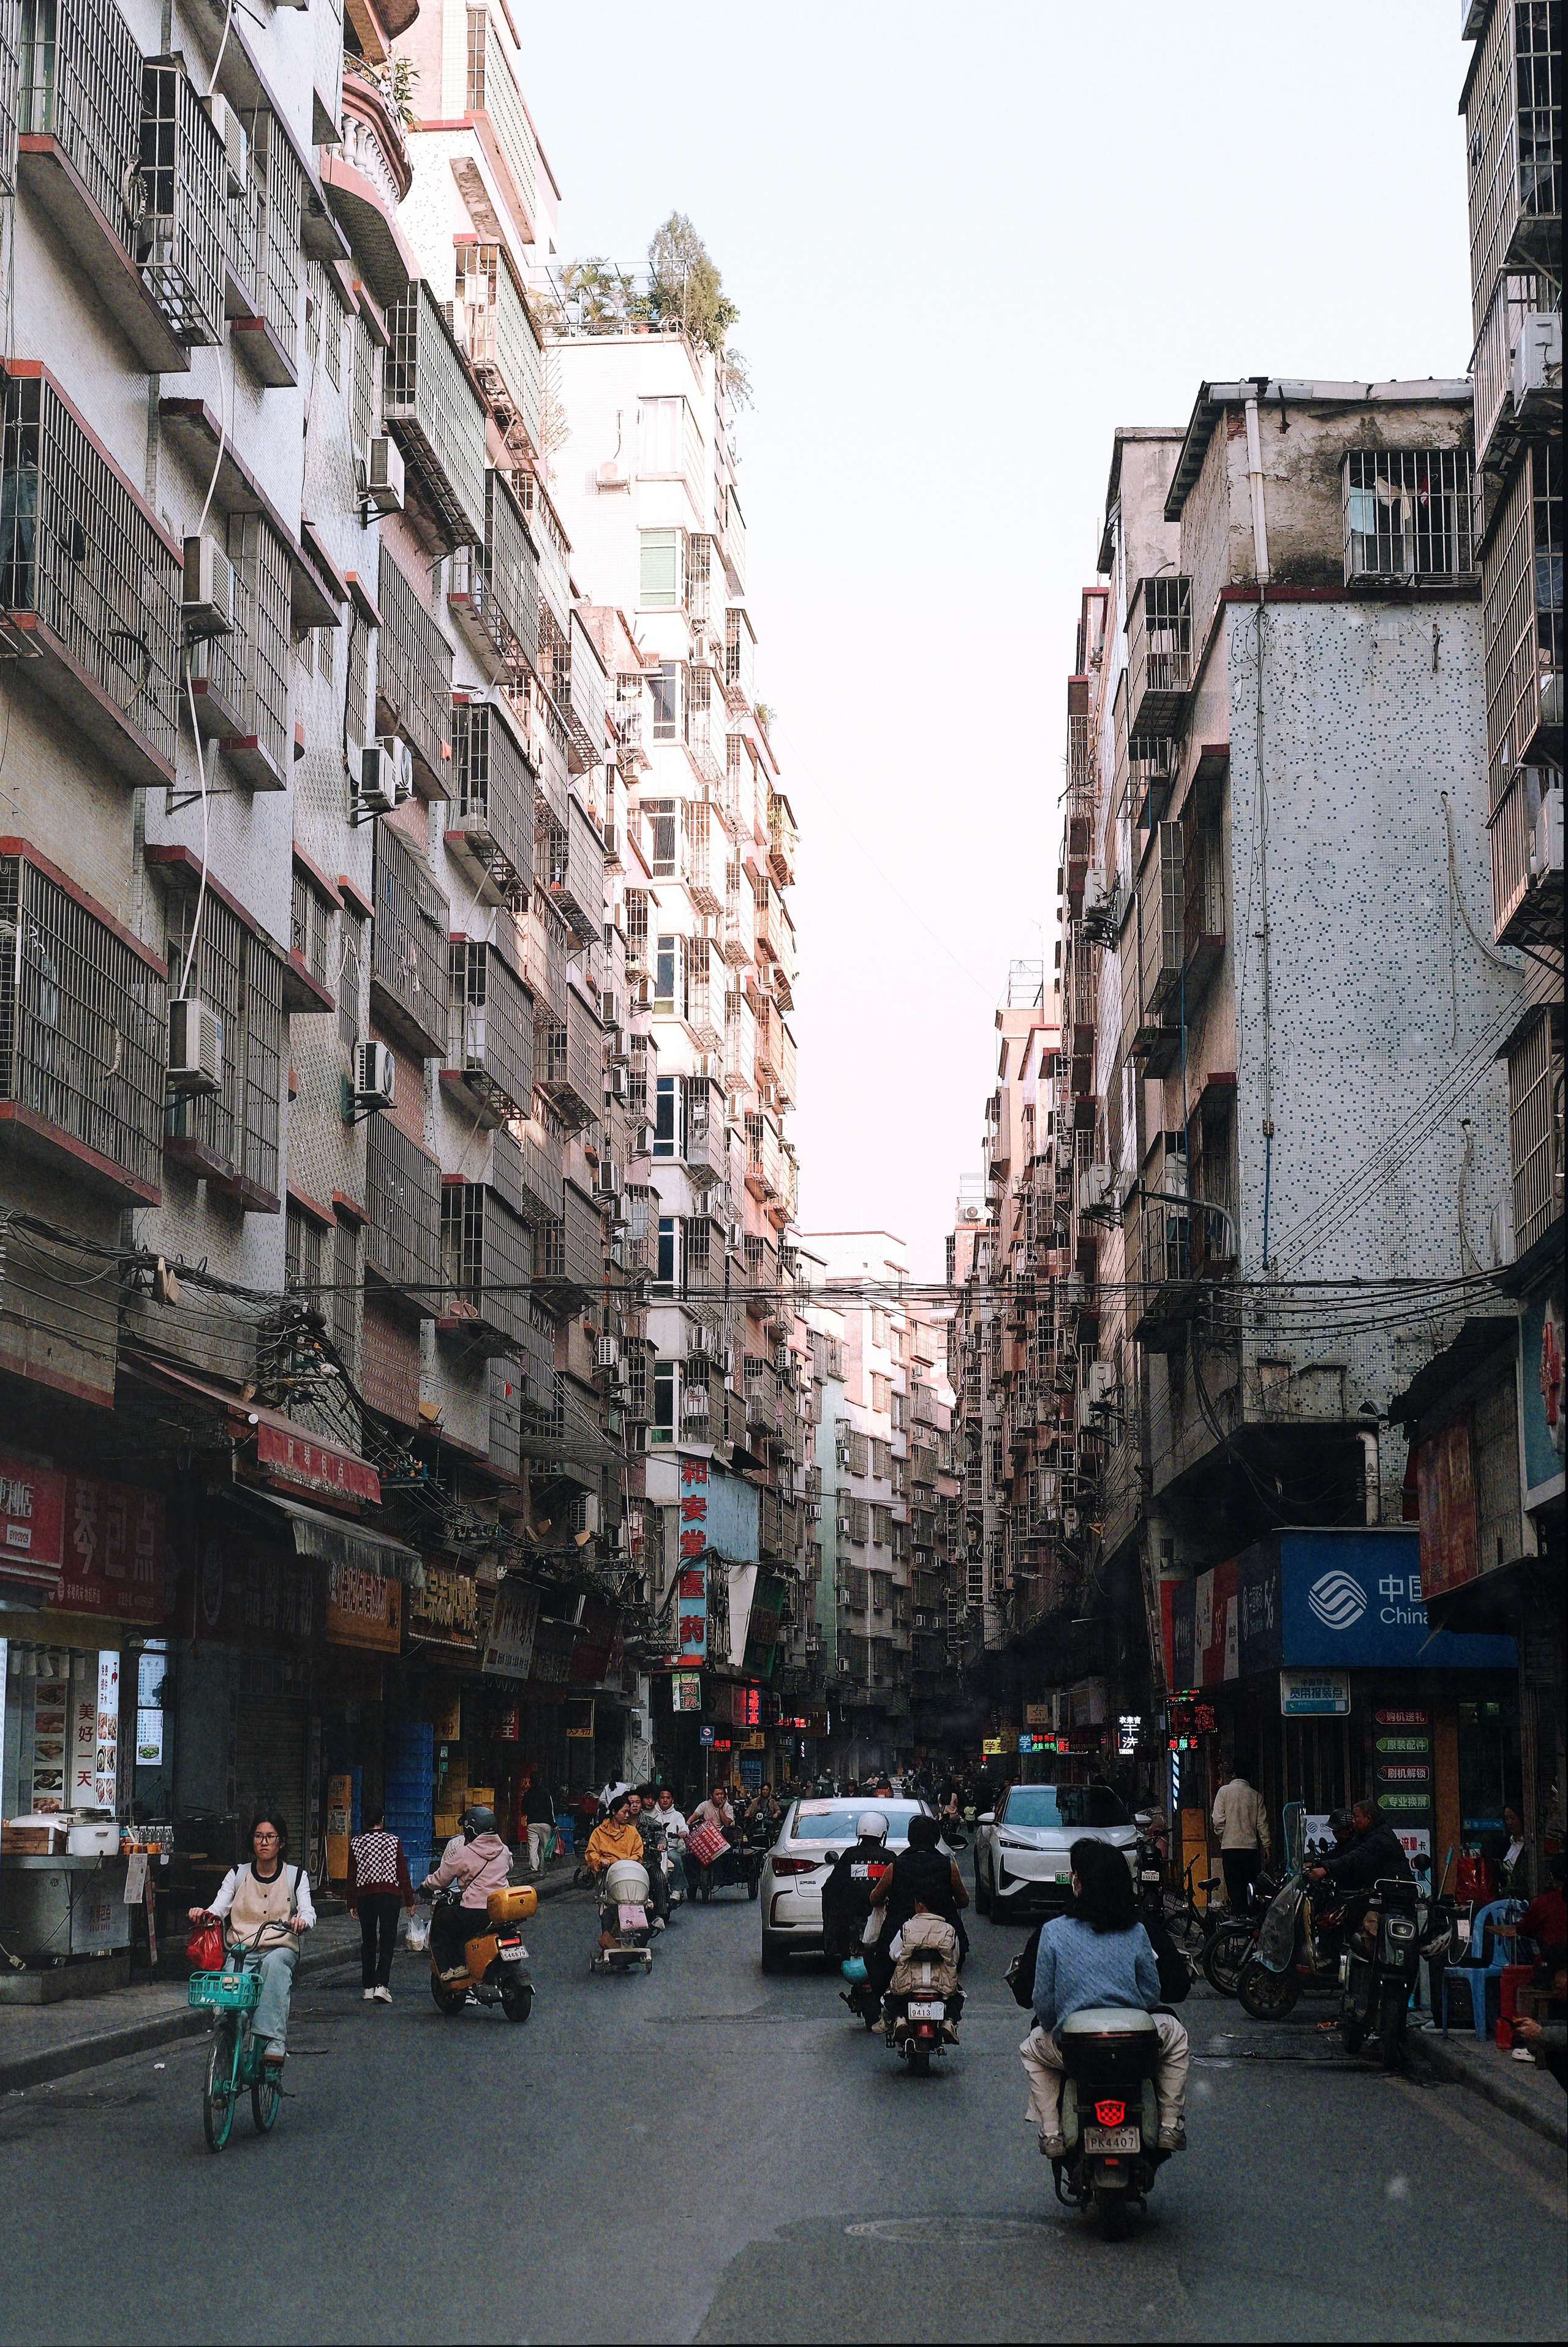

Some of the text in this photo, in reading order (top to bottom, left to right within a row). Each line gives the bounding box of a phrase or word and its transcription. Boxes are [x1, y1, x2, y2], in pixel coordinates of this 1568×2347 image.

[680, 1459, 707, 1642] 和安堂医药
[682, 1682, 698, 1709] 药房
[1290, 1687, 1343, 1699] 宽带报装点
[748, 1689, 760, 1724] 电动工具
[1386, 1712, 1425, 1722] 购机送礼
[1019, 1736, 1031, 1748] 学
[1121, 1725, 1140, 1748] 干洗
[77, 1703, 94, 1787] 美好一天
[1387, 1739, 1425, 1750] 原装配件
[1387, 1768, 1426, 1779] 刷机解锁
[1388, 1796, 1427, 1807] 专业换屏
[1401, 1837, 1427, 1851] 流量卡
[1091, 2137, 1134, 2148] PK4407
